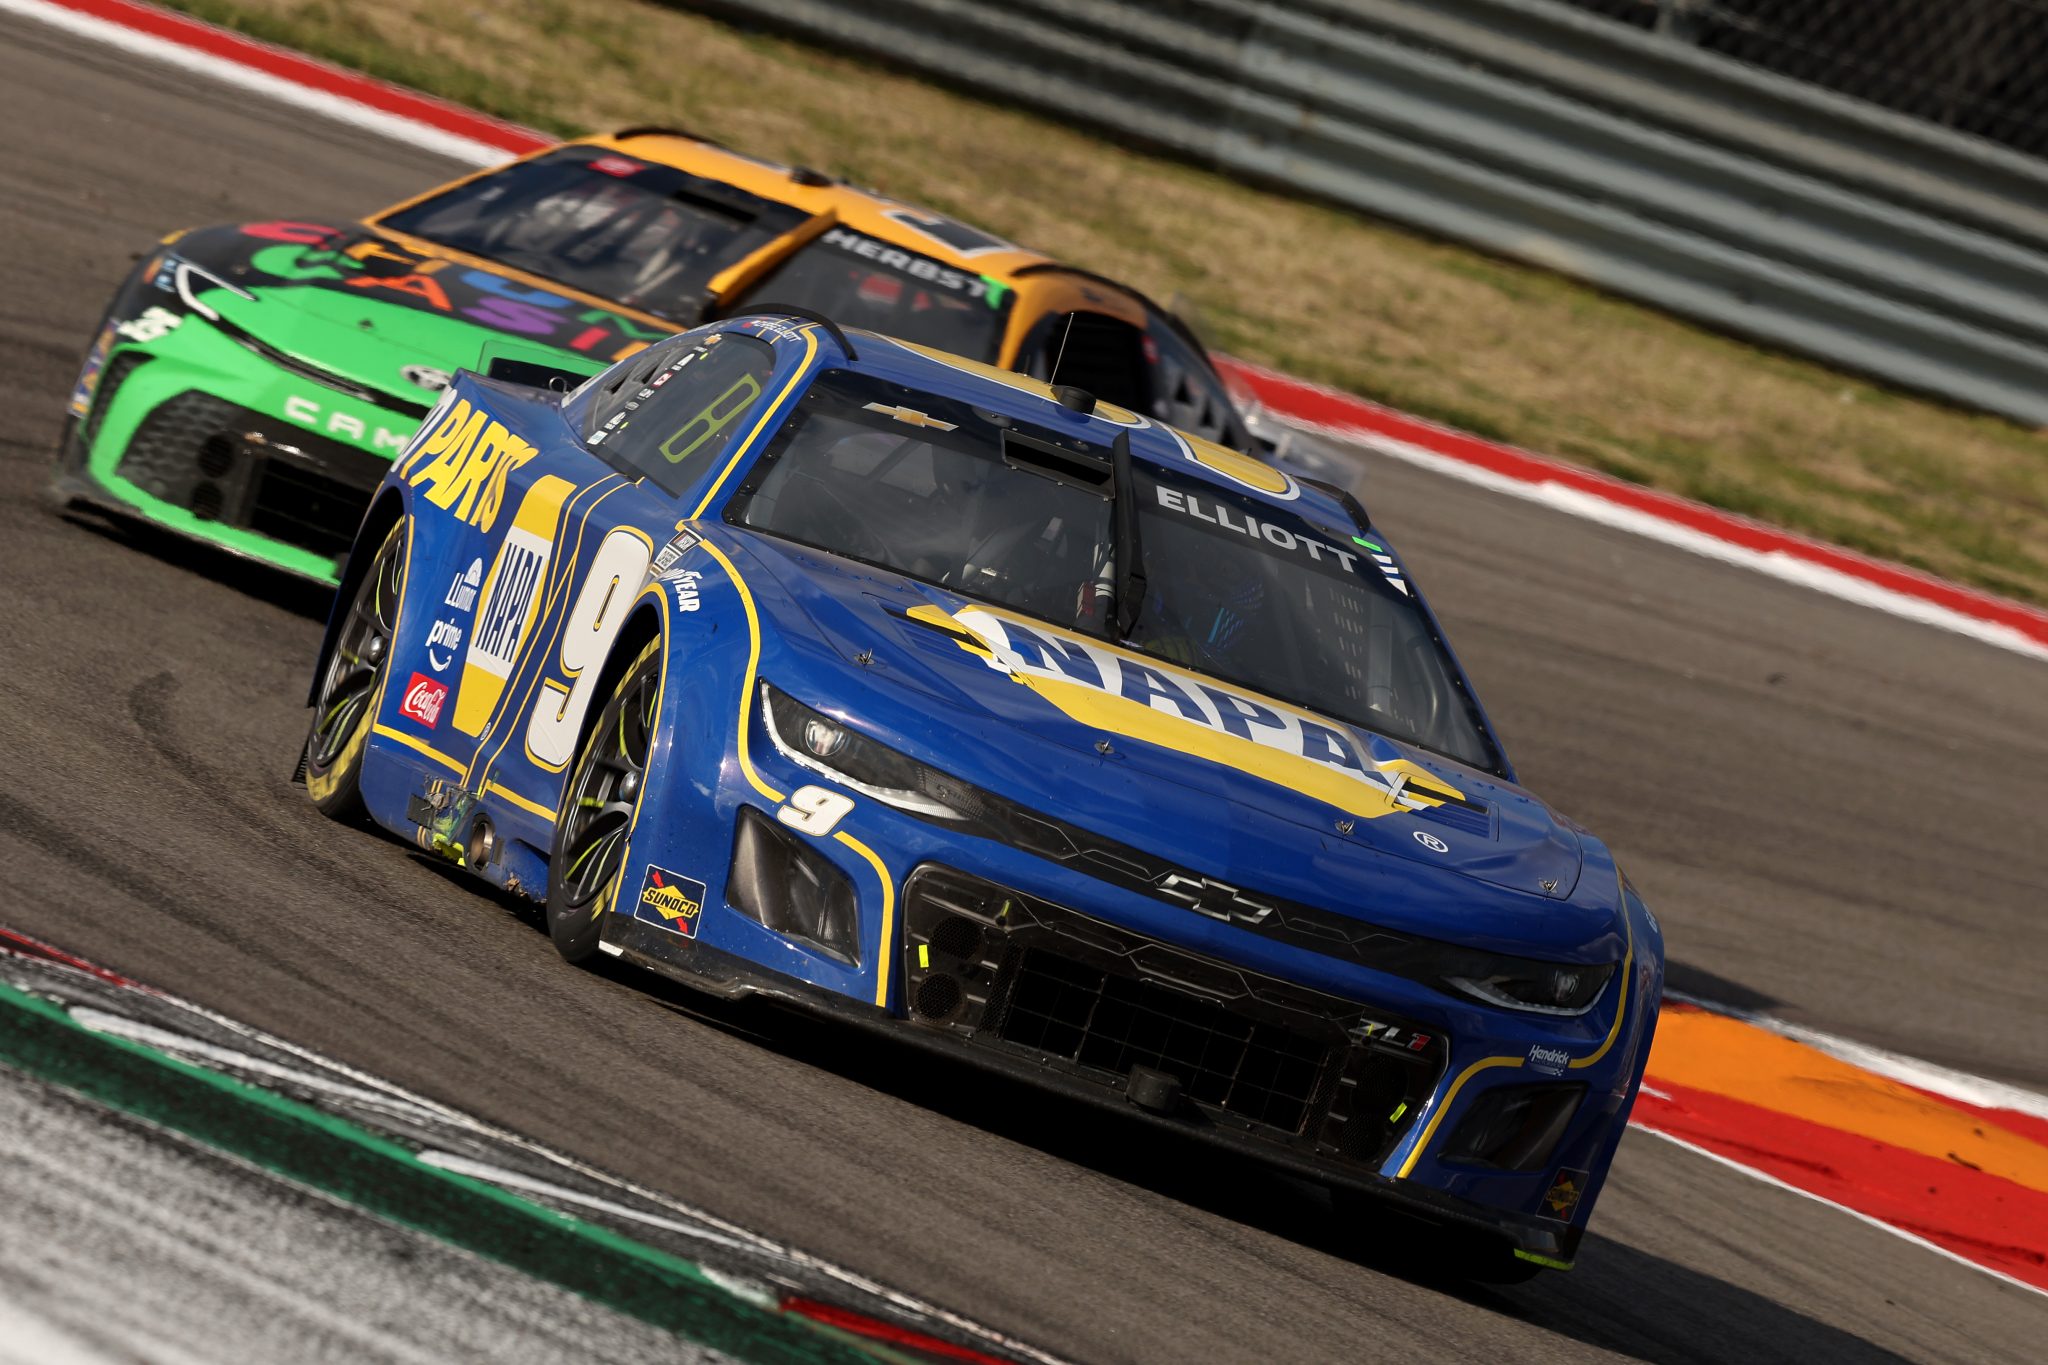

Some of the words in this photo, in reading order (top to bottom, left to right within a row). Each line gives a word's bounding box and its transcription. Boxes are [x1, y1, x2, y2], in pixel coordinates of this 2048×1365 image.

[822, 229, 988, 298] HERBST
[400, 399, 539, 533] PARTS
[1156, 485, 1358, 573] ELLIOTT
[425, 618, 462, 650] prime
[474, 542, 543, 663] NAPA
[526, 526, 653, 773] 9
[994, 617, 1398, 784] NAPA
[777, 785, 856, 836] 9
[644, 889, 697, 916] SUNOCO
[1348, 1018, 1431, 1051] ZL1
[1528, 1044, 1569, 1065] Hendrick
